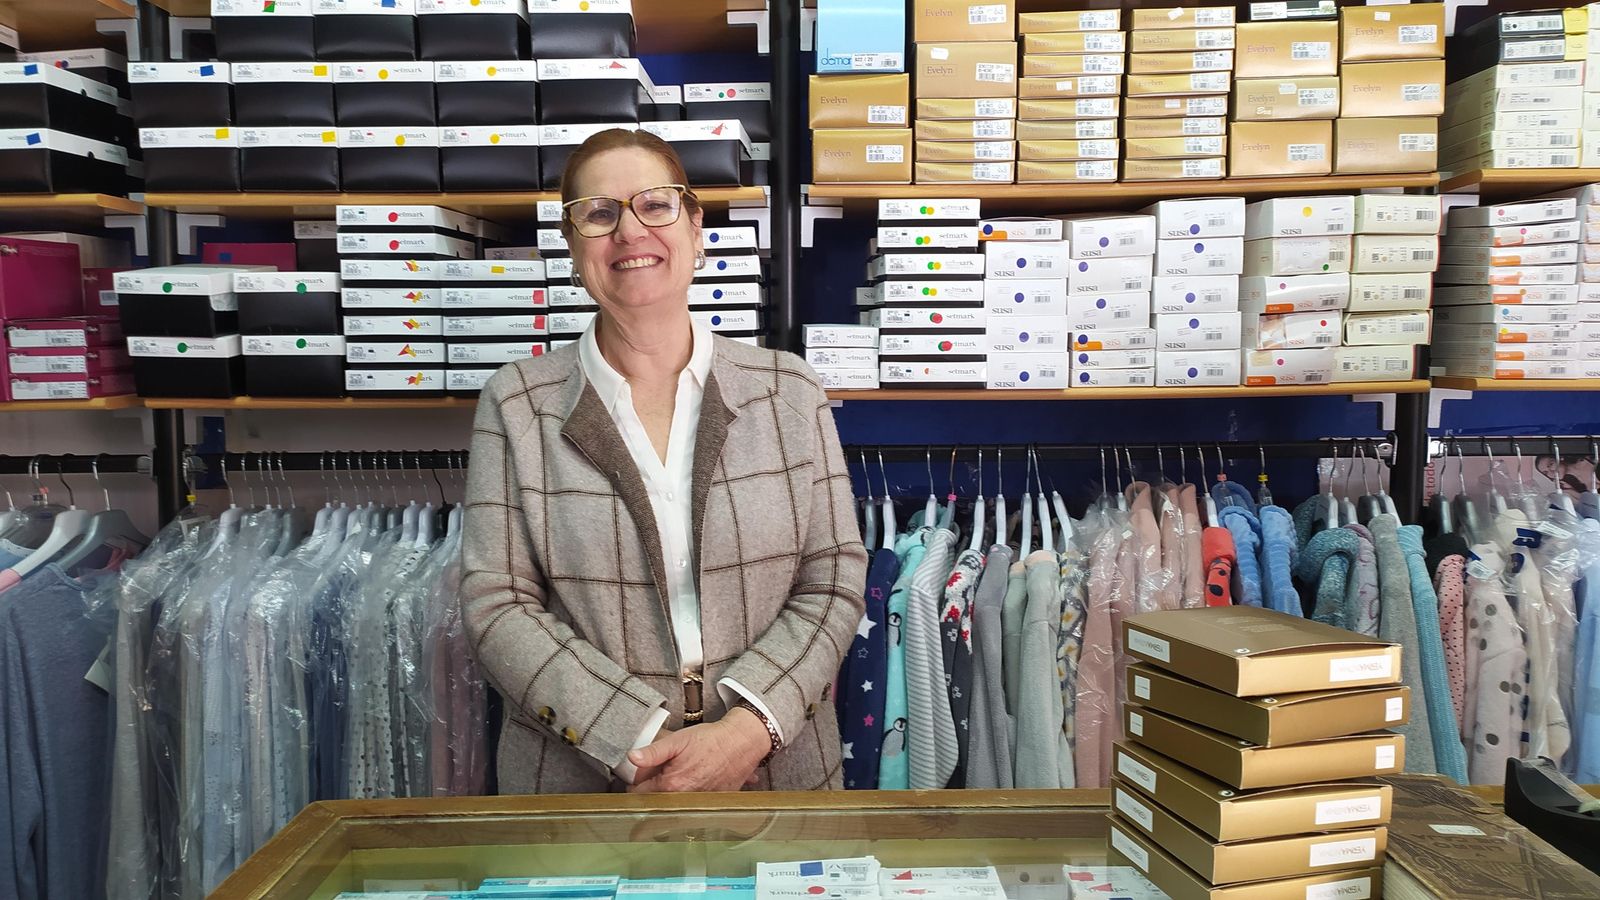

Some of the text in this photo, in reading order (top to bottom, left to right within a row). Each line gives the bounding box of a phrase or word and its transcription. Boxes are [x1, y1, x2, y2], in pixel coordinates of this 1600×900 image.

[925, 8, 953, 17] Evelyn
[1355, 28, 1383, 36] Evelyn
[1247, 45, 1275, 54] Evelyn
[927, 66, 953, 75] Evelyn
[1353, 85, 1381, 93] Evelyn
[820, 96, 848, 105] Evelyn
[1248, 94, 1275, 103] Evelyn
[1242, 143, 1270, 152] Evelyn
[824, 150, 851, 158] Evelyn
